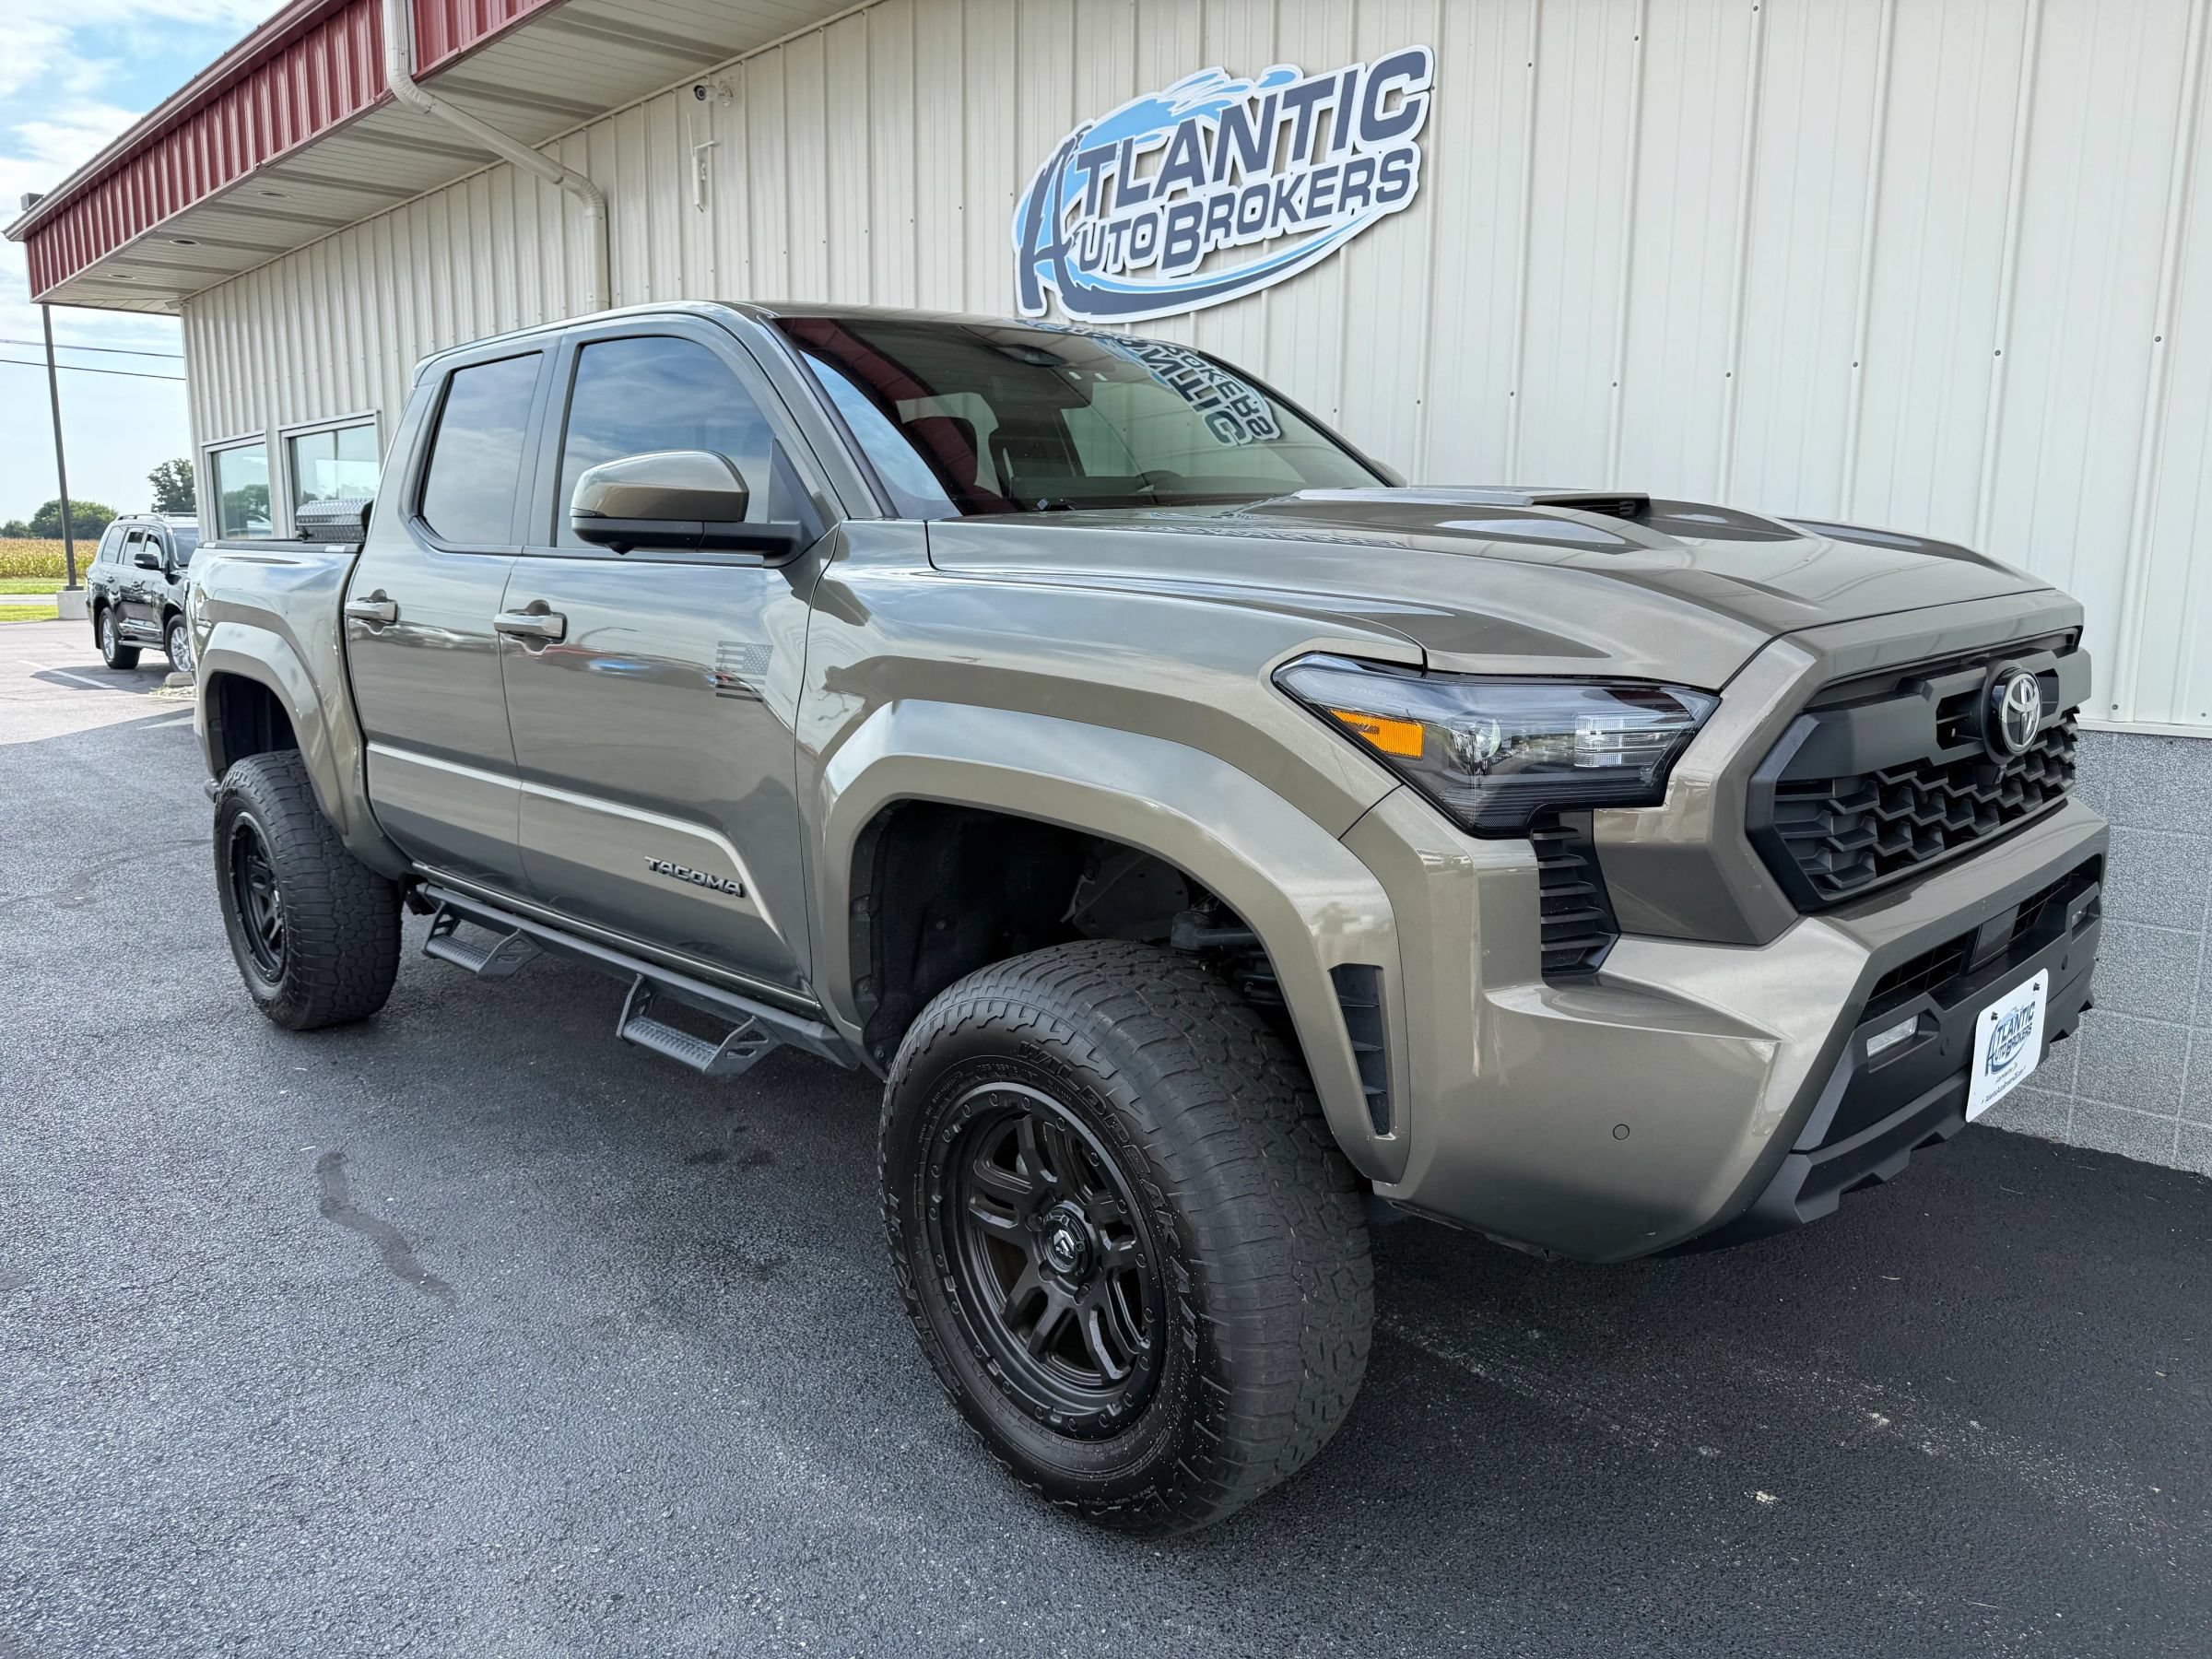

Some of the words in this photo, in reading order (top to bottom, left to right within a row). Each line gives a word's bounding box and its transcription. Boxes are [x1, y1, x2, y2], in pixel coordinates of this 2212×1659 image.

[1021, 51, 1425, 309] ATLANTIC
[644, 855, 746, 898] TACOMA
[1985, 1001, 2035, 1077] ATLANTIC
[1018, 1041, 1181, 1249] WILDPEAK
[1055, 1246, 1074, 1259] FUEL
